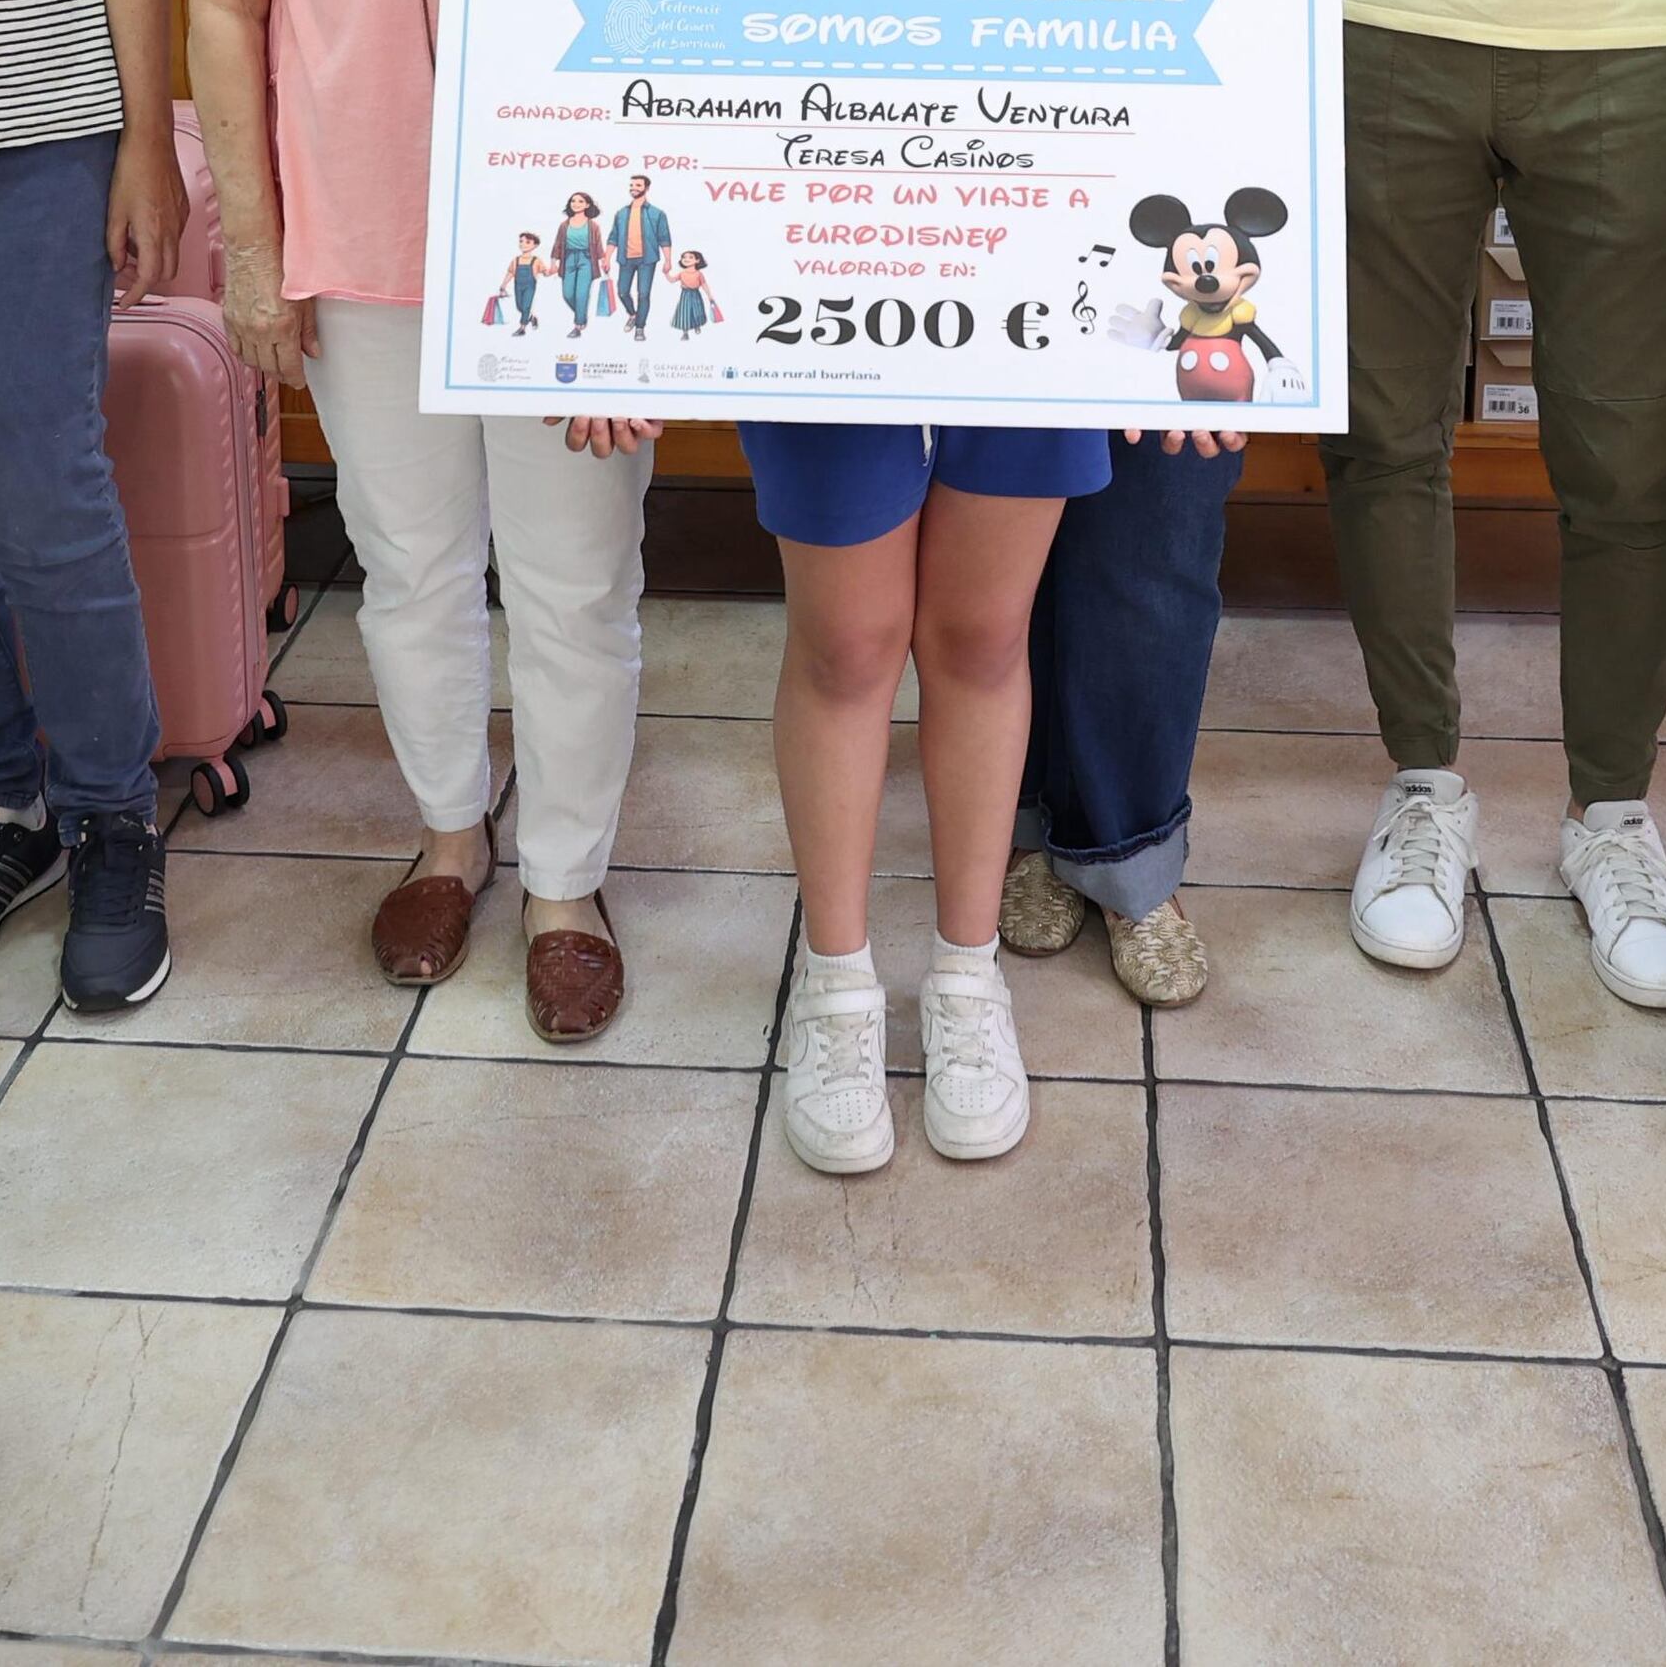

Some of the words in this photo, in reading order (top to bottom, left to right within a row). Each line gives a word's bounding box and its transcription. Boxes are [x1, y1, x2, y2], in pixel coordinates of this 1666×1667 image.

[741, 12, 942, 46] SOMOS
[970, 16, 1178, 52] FAMILIA
[496, 105, 611, 121] GANADOR:
[487, 151, 630, 169] ENTREGADO
[642, 154, 699, 171] POR:
[704, 180, 787, 203] VALE
[806, 182, 875, 205] POR
[893, 184, 939, 206] UN
[955, 185, 1051, 208] VIAJE
[1068, 188, 1091, 209] A
[785, 223, 1008, 255] EURODISNEY
[793, 259, 927, 277] VALORADO
[939, 261, 978, 278] EN:
[755, 295, 975, 349] 2500
[1000, 300, 1051, 351] €
[653, 364, 715, 372] GENERALITAT
[653, 371, 714, 380] VALENCIANA
[742, 367, 780, 379] caixa
[782, 367, 817, 380] rural
[820, 369, 882, 381] burriana
